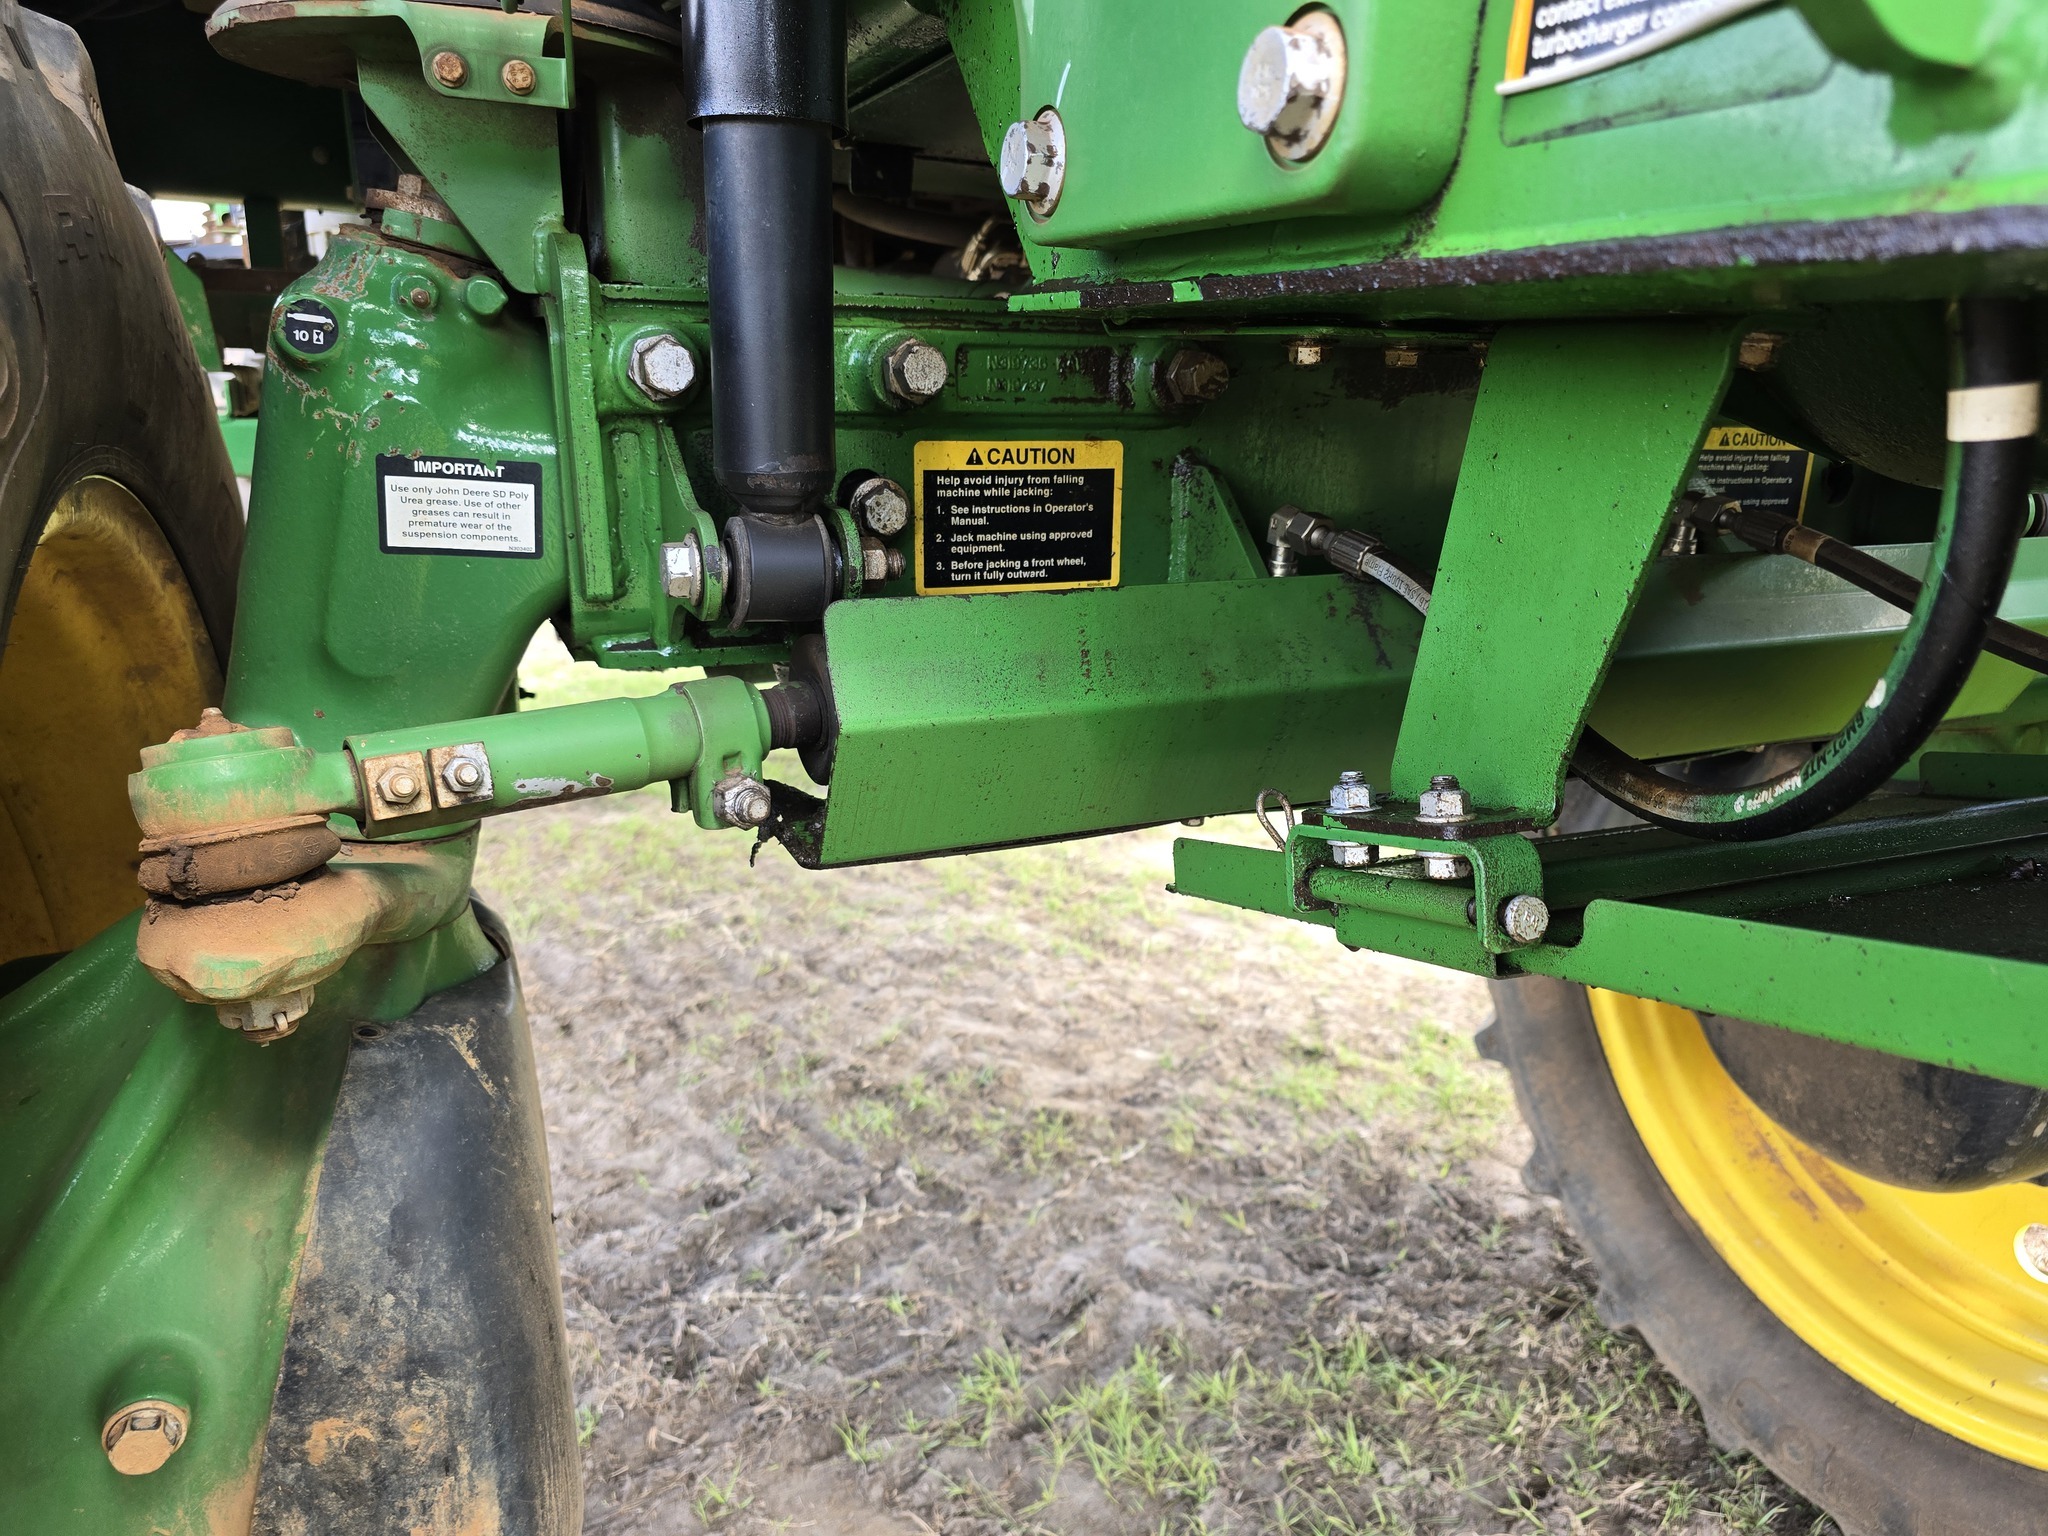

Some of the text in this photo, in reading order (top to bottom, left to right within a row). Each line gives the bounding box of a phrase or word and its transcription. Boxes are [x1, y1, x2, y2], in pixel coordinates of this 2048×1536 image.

[1532, 13, 1650, 59] turbocharger
[293, 329, 309, 342] 10
[987, 448, 1075, 465] CAUTION
[1734, 454, 1753, 463] injury
[1770, 454, 1790, 463] falling
[414, 460, 505, 478] IMPORTANT
[1743, 464, 1769, 472] jacking:
[937, 474, 1084, 486] Help avoid injury from falling
[1762, 476, 1792, 485] Operator's
[390, 484, 529, 501] Use only John Deere SD Poly
[937, 486, 1053, 498] machine while jacking:
[400, 496, 521, 510] Urea grease. Use of other
[1743, 498, 1759, 506] using
[1761, 498, 1789, 506] approved
[412, 509, 450, 519] greases
[472, 510, 500, 520] result
[502, 512, 511, 520] in
[936, 503, 1094, 515] 1. See instructions in Operator's
[408, 520, 512, 531] premature wear of the
[951, 516, 989, 526] Manual.
[402, 530, 522, 543] suspension components.
[935, 529, 1093, 543] 2. Jack machine using approved
[951, 543, 1005, 554] equipment.
[936, 556, 1087, 571] 3. Before jacking a front wheel,
[951, 569, 1048, 582] turn it fully outward.
